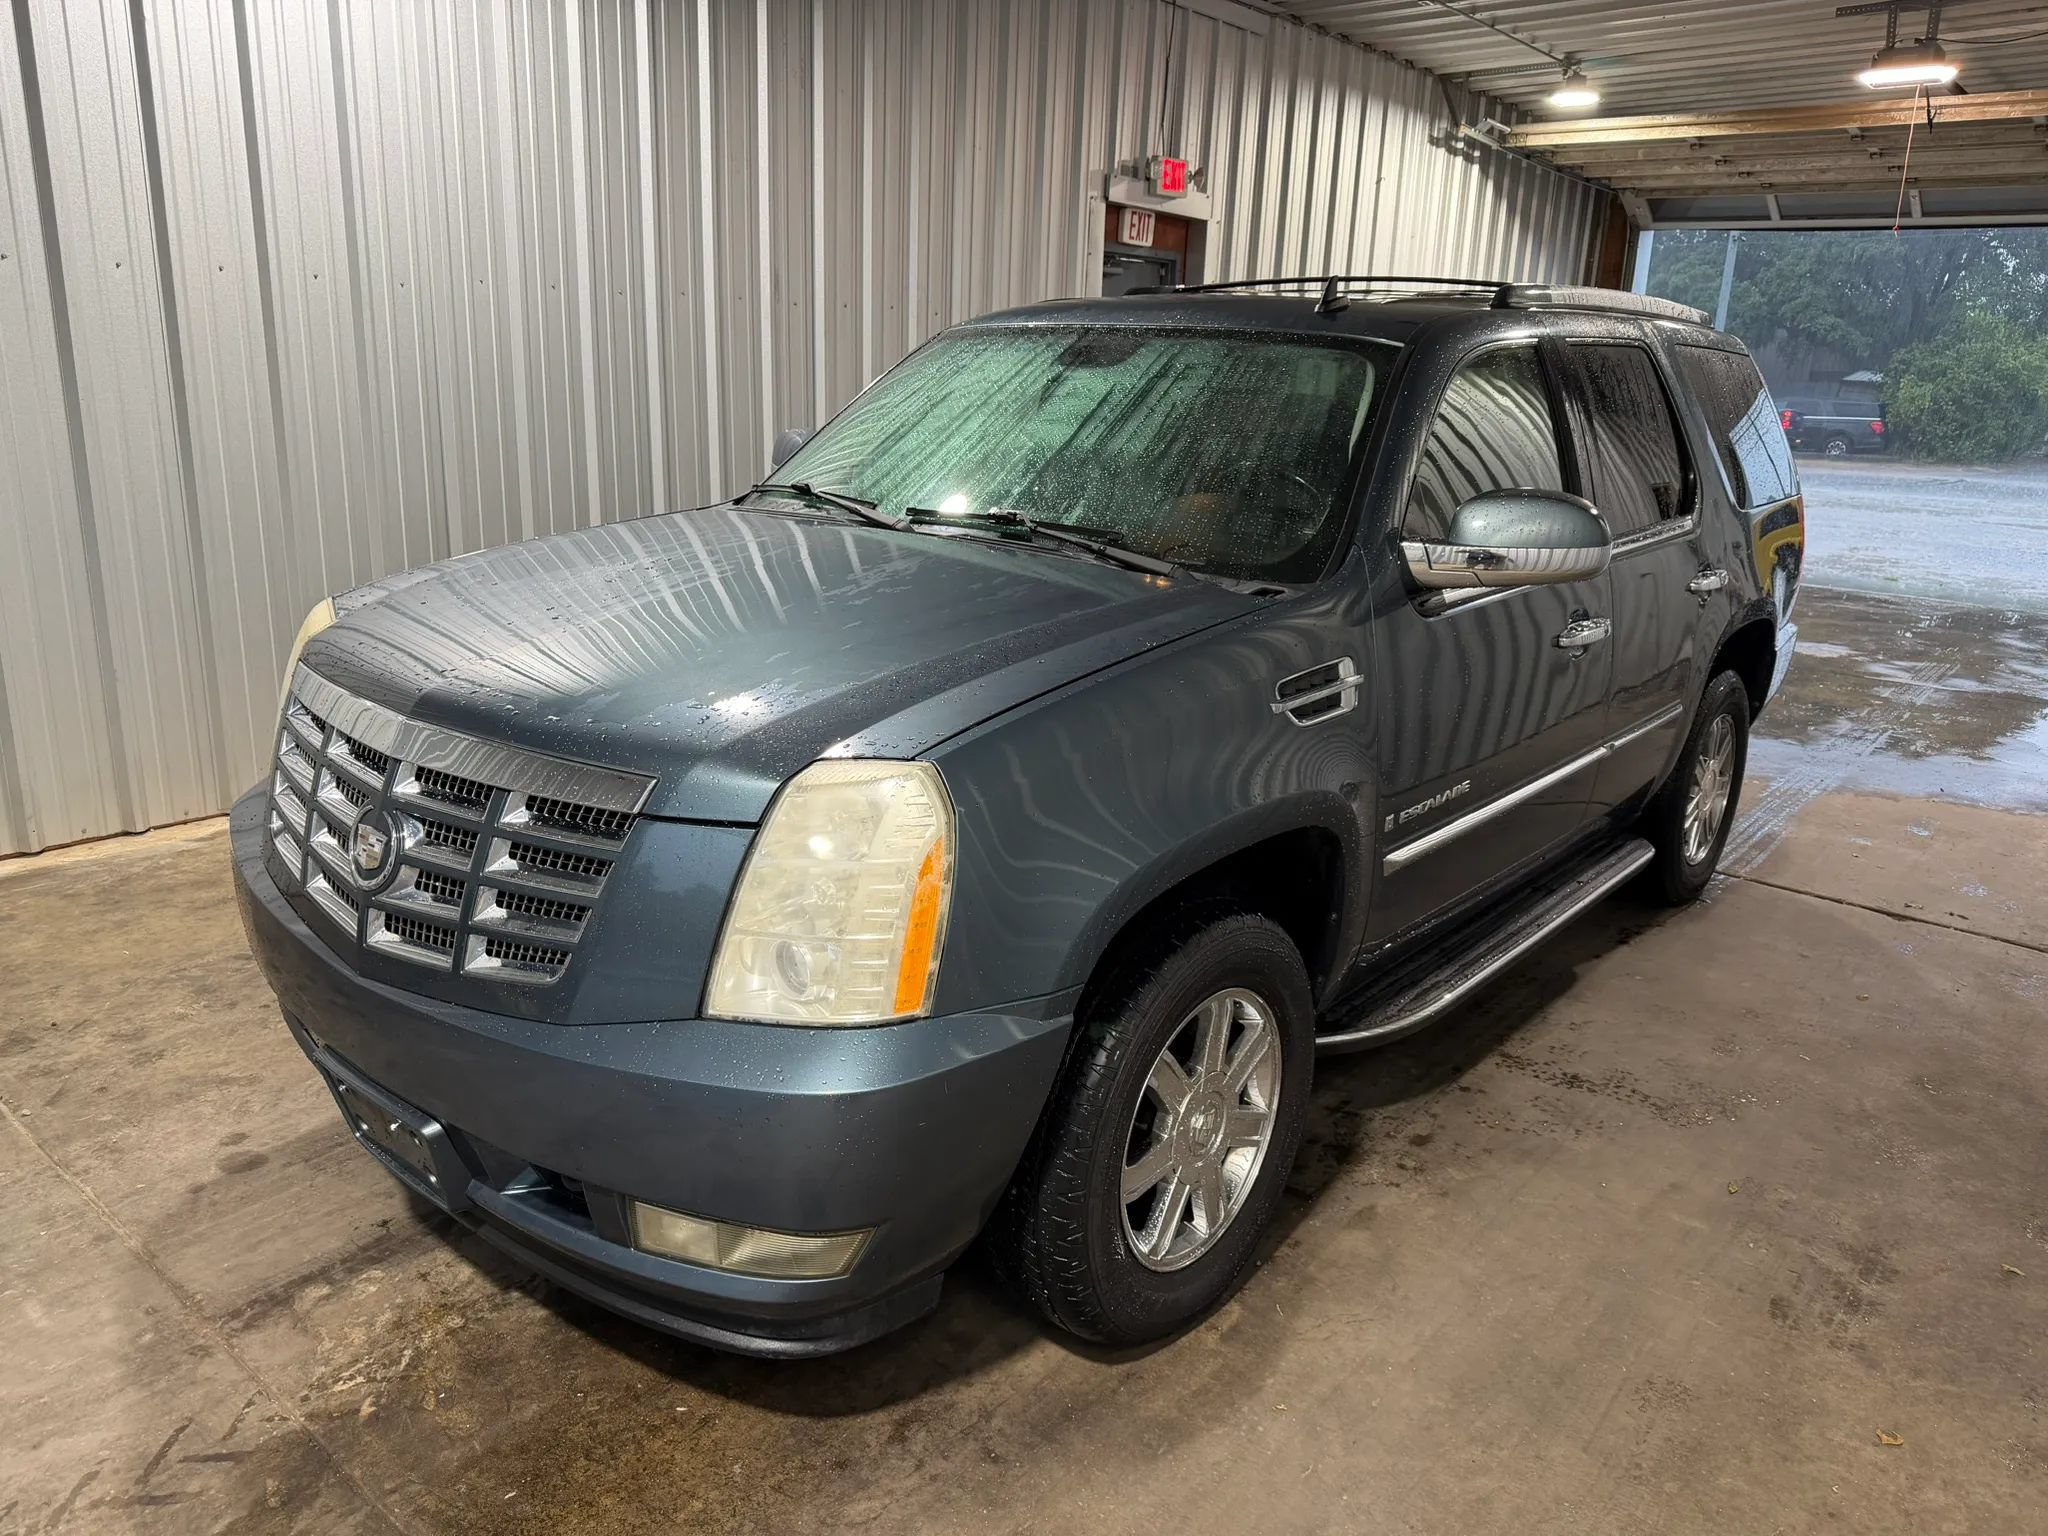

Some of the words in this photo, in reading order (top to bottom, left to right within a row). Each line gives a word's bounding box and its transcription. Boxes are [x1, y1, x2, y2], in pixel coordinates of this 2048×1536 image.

[1162, 159, 1187, 192] EXIT
[1128, 211, 1152, 243] EXIT
[1399, 780, 1471, 824] ESCALADE
